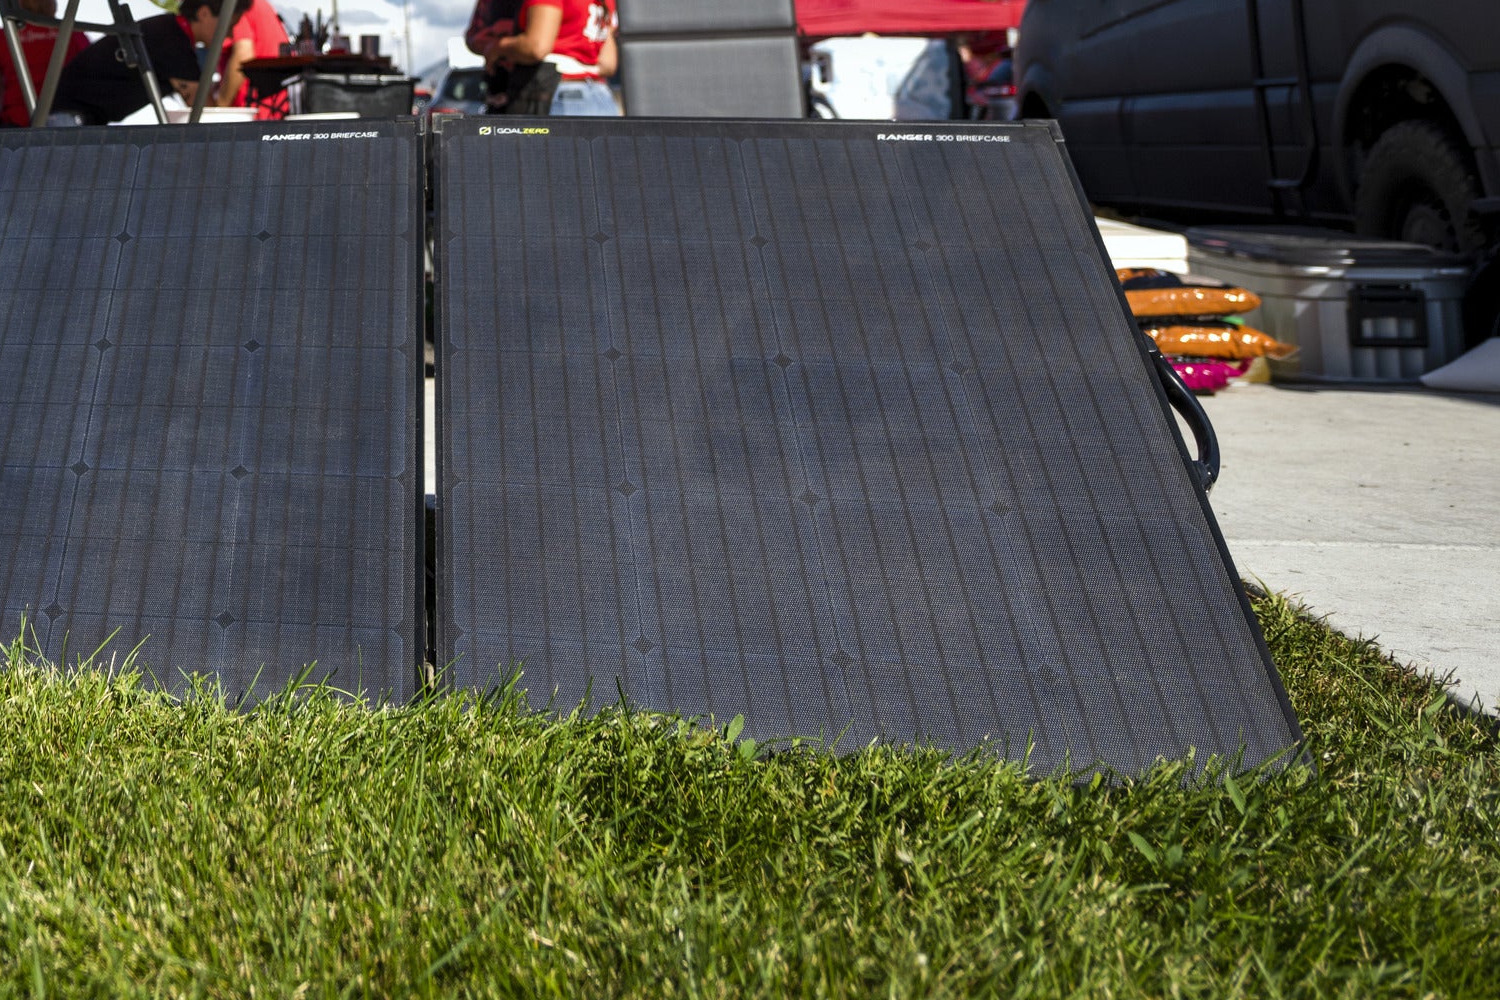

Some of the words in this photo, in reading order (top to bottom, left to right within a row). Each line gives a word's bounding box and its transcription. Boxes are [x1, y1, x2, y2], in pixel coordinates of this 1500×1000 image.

[261, 133, 311, 141] RANGER
[312, 132, 330, 140] 300
[330, 131, 379, 140] BRIEFCASE
[877, 133, 933, 141] RANGER
[935, 134, 954, 142] 300
[956, 135, 1011, 143] BRIEFCASE
